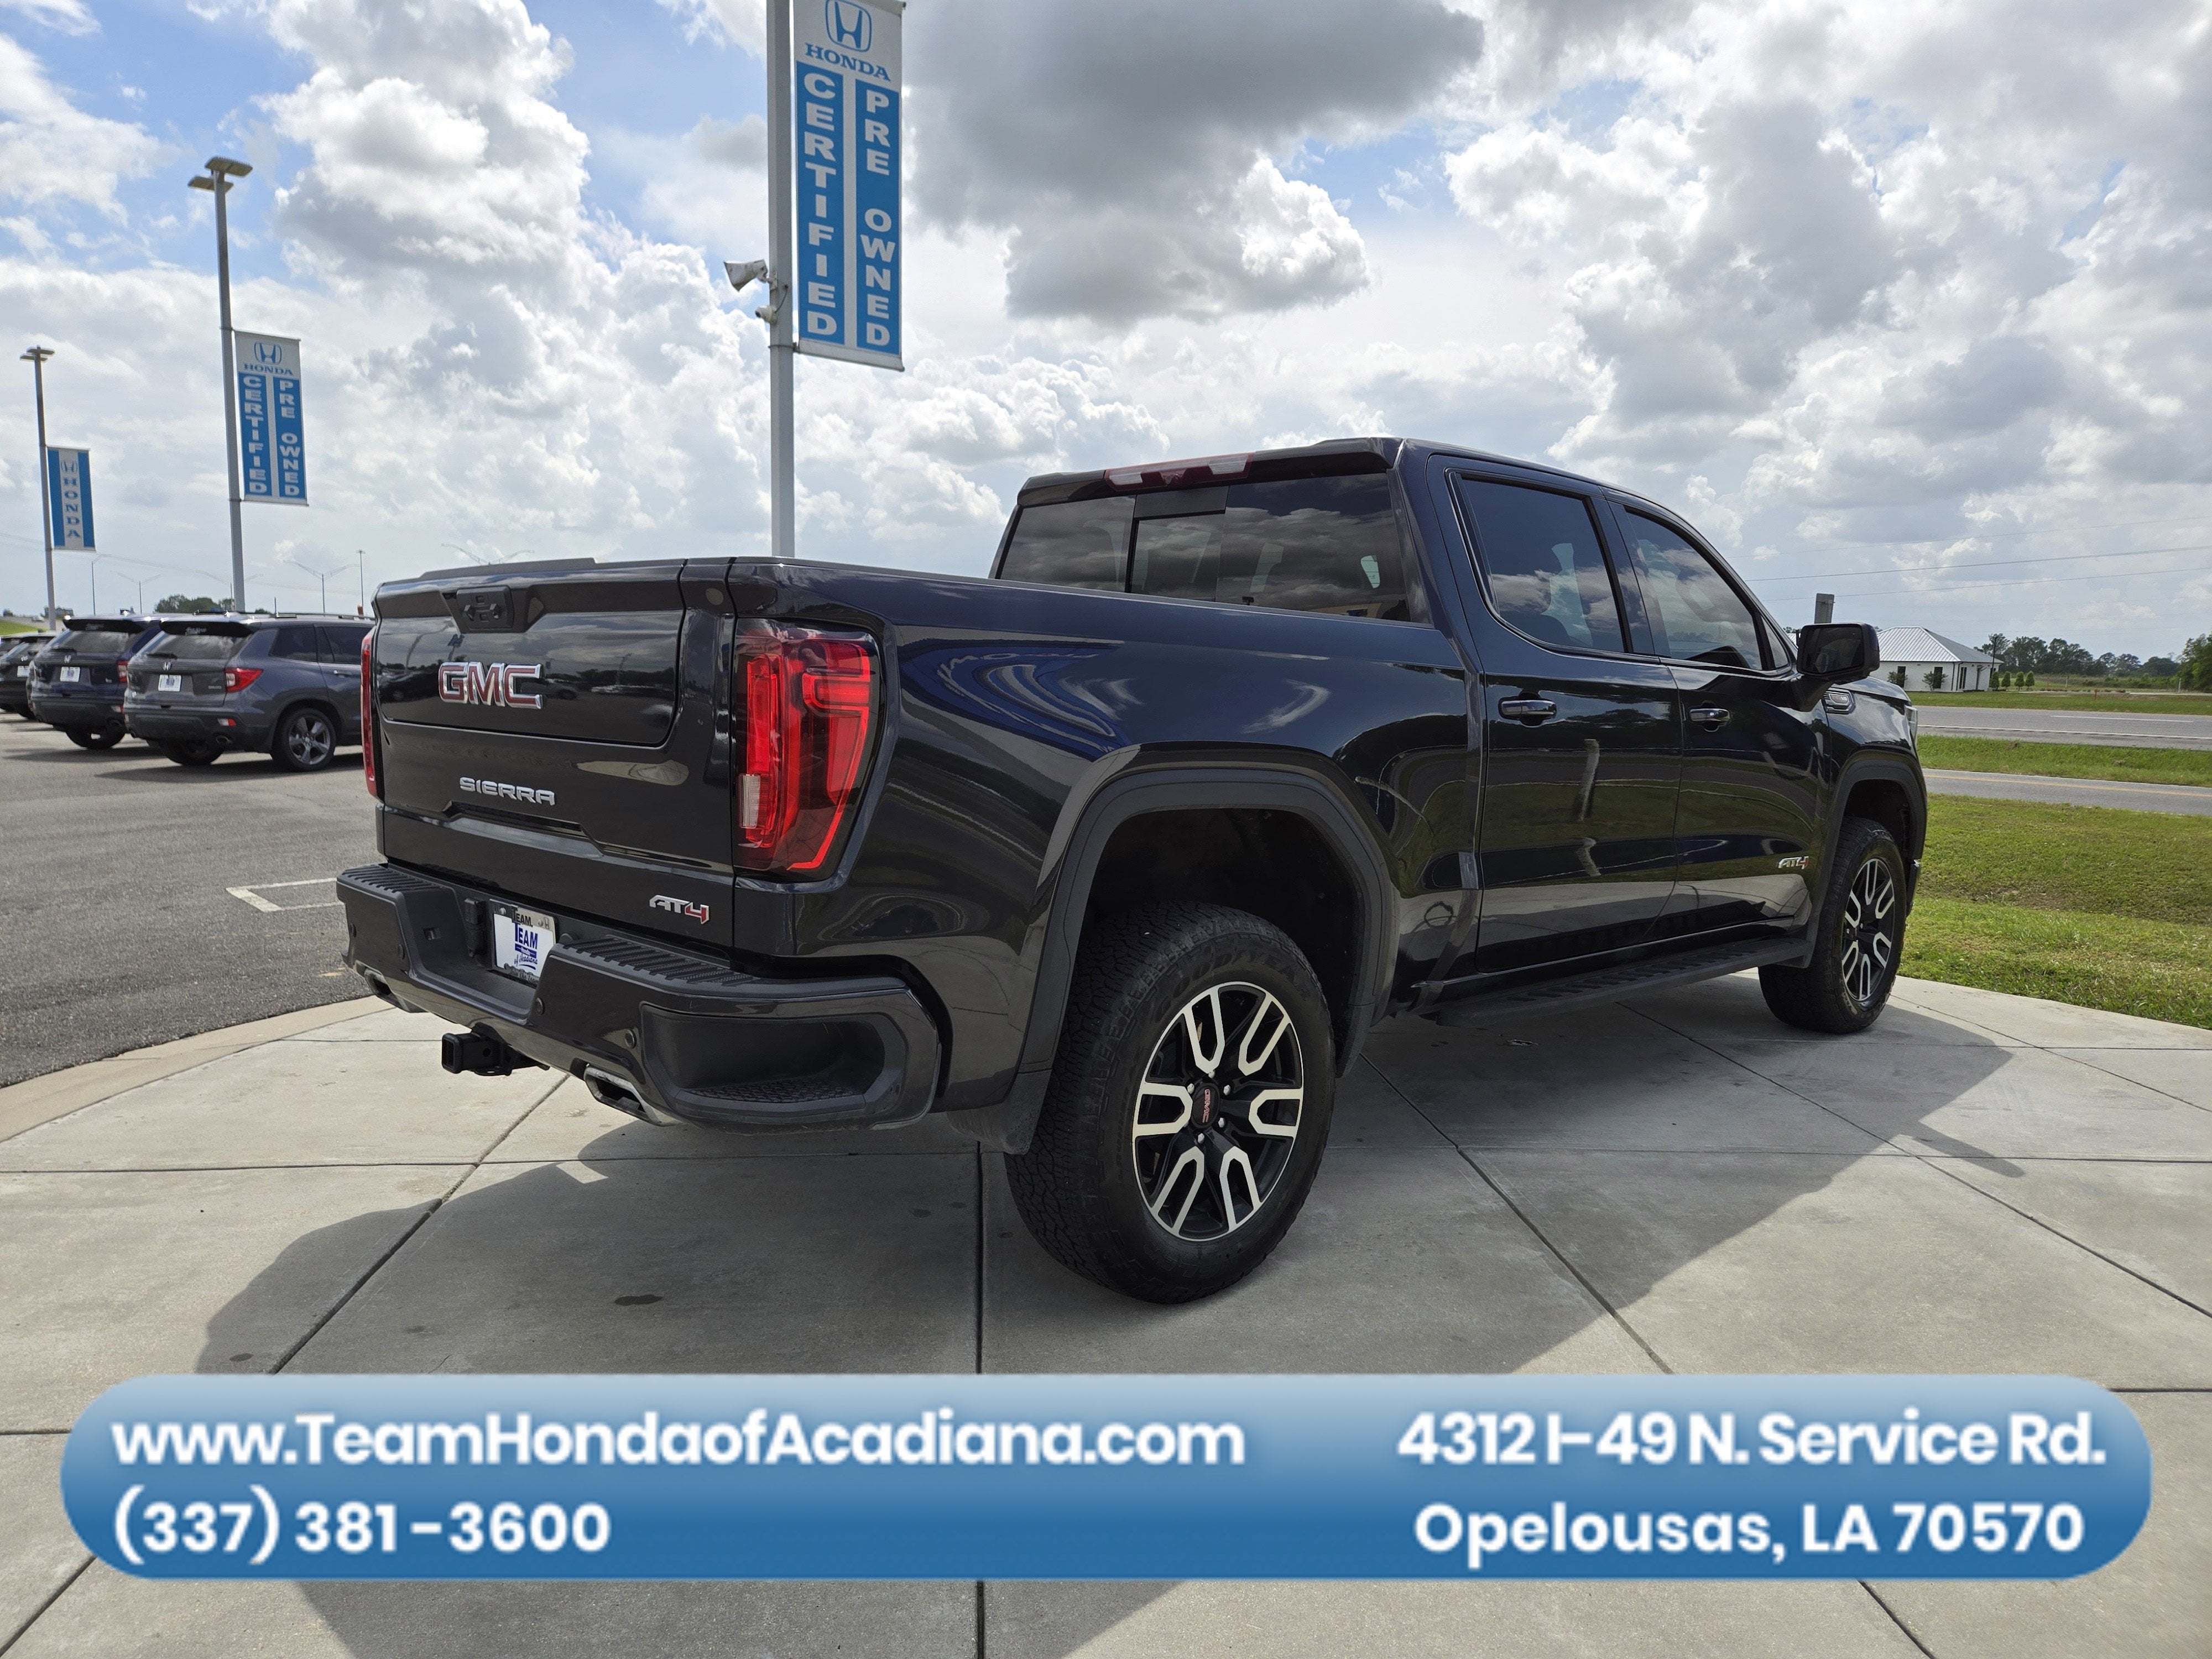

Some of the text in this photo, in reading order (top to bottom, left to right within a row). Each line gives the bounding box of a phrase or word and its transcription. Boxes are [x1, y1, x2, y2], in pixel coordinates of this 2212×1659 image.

[805, 43, 891, 81] HONDA
[804, 72, 837, 336] CERTIFIED
[860, 89, 895, 346] PRE OWNED
[243, 363, 293, 375] HONDA
[243, 375, 267, 494] CERTIFIED
[279, 380, 300, 496] PRE OWNED
[64, 478, 80, 538] HONDA
[439, 661, 543, 709] GMC
[460, 777, 555, 806] SIERRA
[1778, 856, 1809, 869] AT4
[649, 895, 709, 925] AT4
[514, 922, 538, 950] TEAM
[1202, 1089, 1211, 1123] GMC
